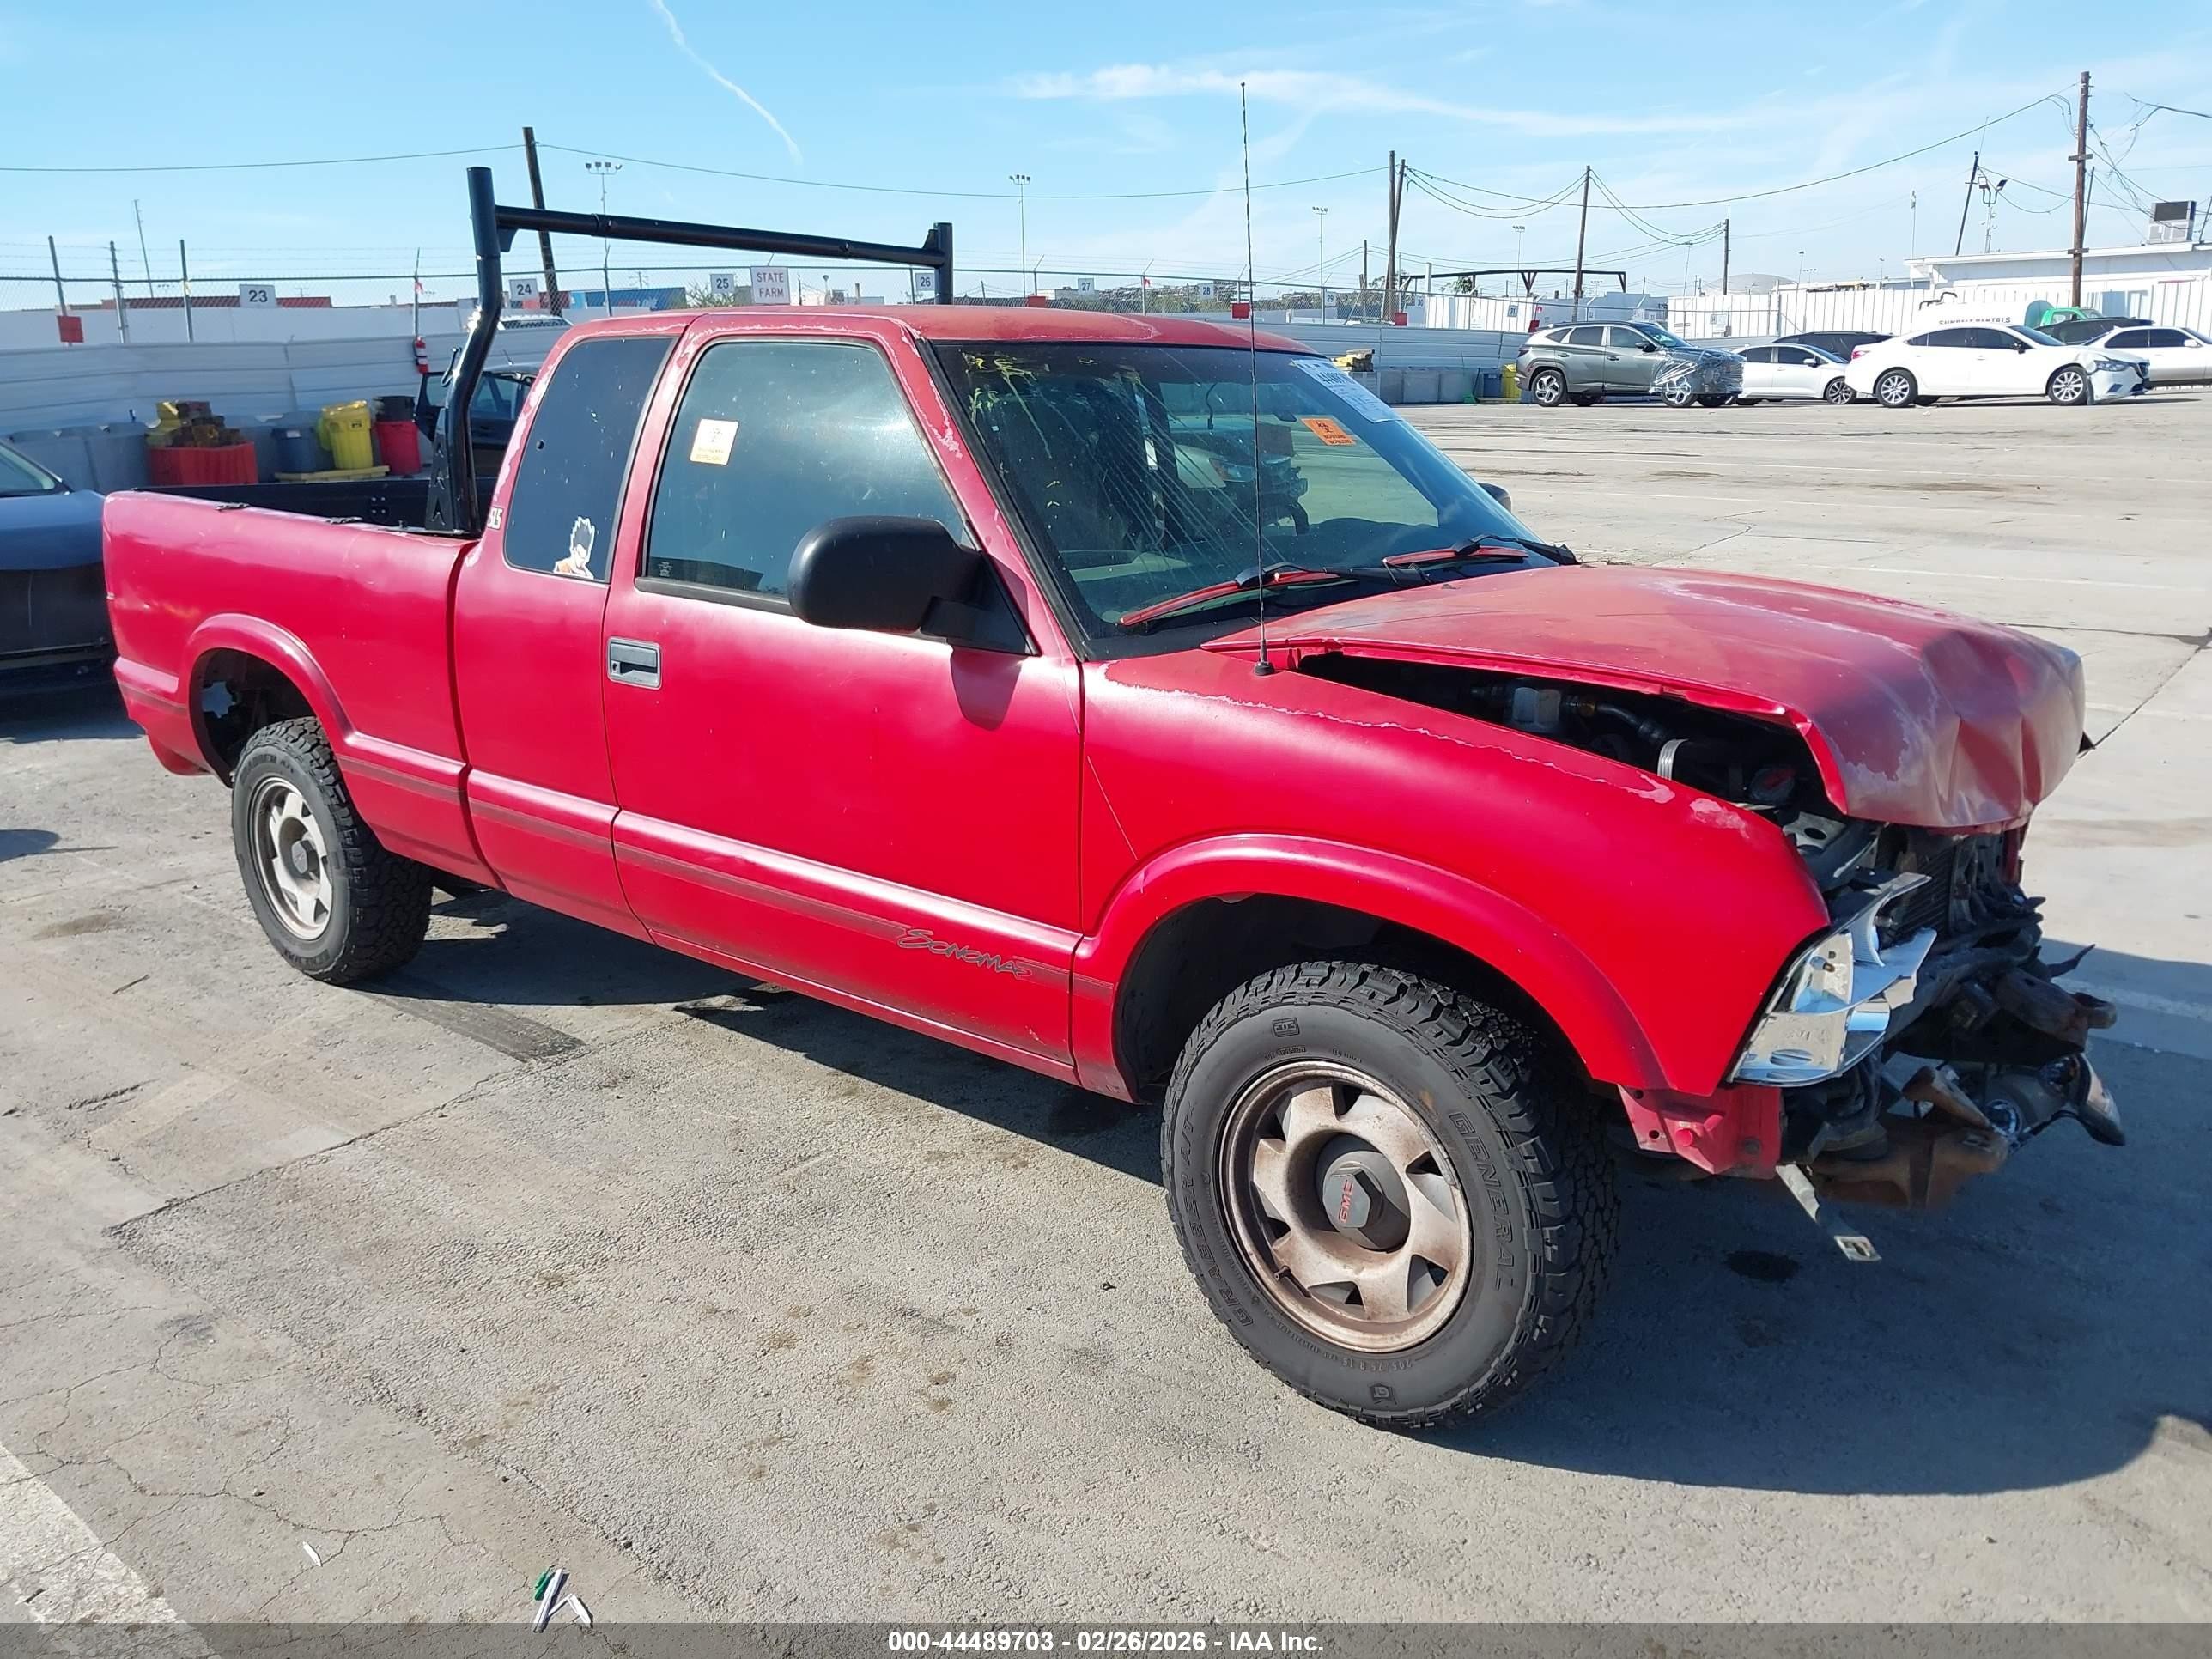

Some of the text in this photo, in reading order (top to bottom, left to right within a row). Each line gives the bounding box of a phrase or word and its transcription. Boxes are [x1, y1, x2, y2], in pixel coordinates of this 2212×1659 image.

[716, 277, 729, 289] 25
[756, 272, 784, 283] STATE
[920, 276, 932, 287] 26
[516, 283, 532, 295] 24
[1081, 282, 1091, 291] 27
[1202, 286, 1211, 295] 28
[249, 289, 267, 302] 23
[759, 288, 784, 297] FARM
[1338, 1179, 1354, 1224] GMC
[1449, 1111, 1515, 1291] GENERAL
